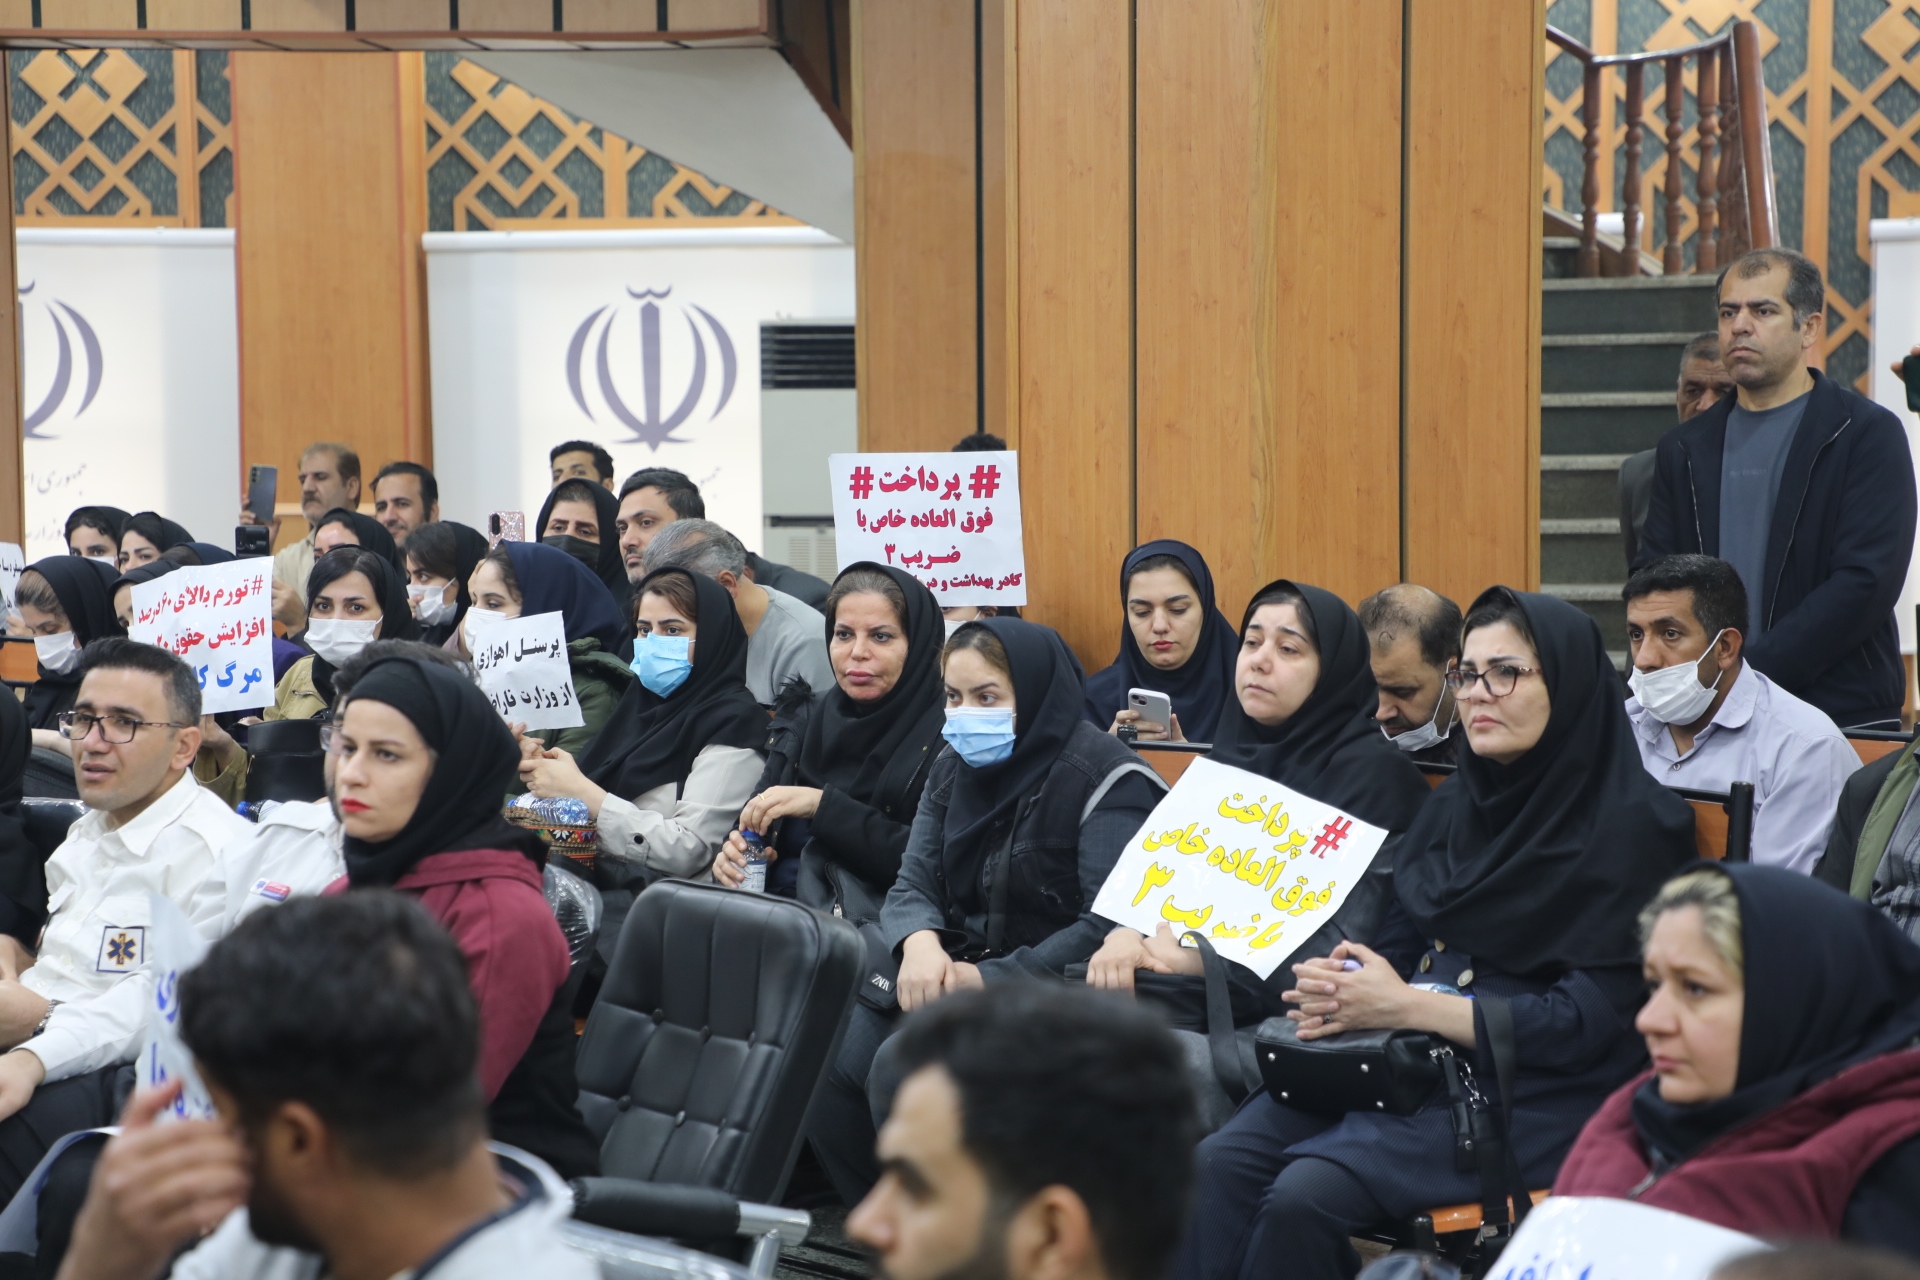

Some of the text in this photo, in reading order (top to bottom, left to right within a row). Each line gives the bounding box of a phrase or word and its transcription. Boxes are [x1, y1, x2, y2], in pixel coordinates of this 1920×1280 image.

[878, 465, 962, 501] پرداخت
[856, 506, 993, 533] فوق العاده خاص با
[884, 543, 961, 569] ضریب ۳
[940, 579, 948, 591] و
[949, 573, 994, 589] بهداشت
[998, 573, 1022, 591] کادر
[173, 584, 211, 613] بالای
[172, 627, 205, 656] حقوق
[208, 617, 265, 649] افزایش
[476, 637, 561, 670] پرسنل اهوازی
[216, 660, 262, 693] مرگ
[491, 681, 573, 715] از وزارت ناراض
[1142, 822, 1336, 916] فوق العاده خاص
[1131, 862, 1175, 907] ۳
[871, 973, 890, 992] ZARA
